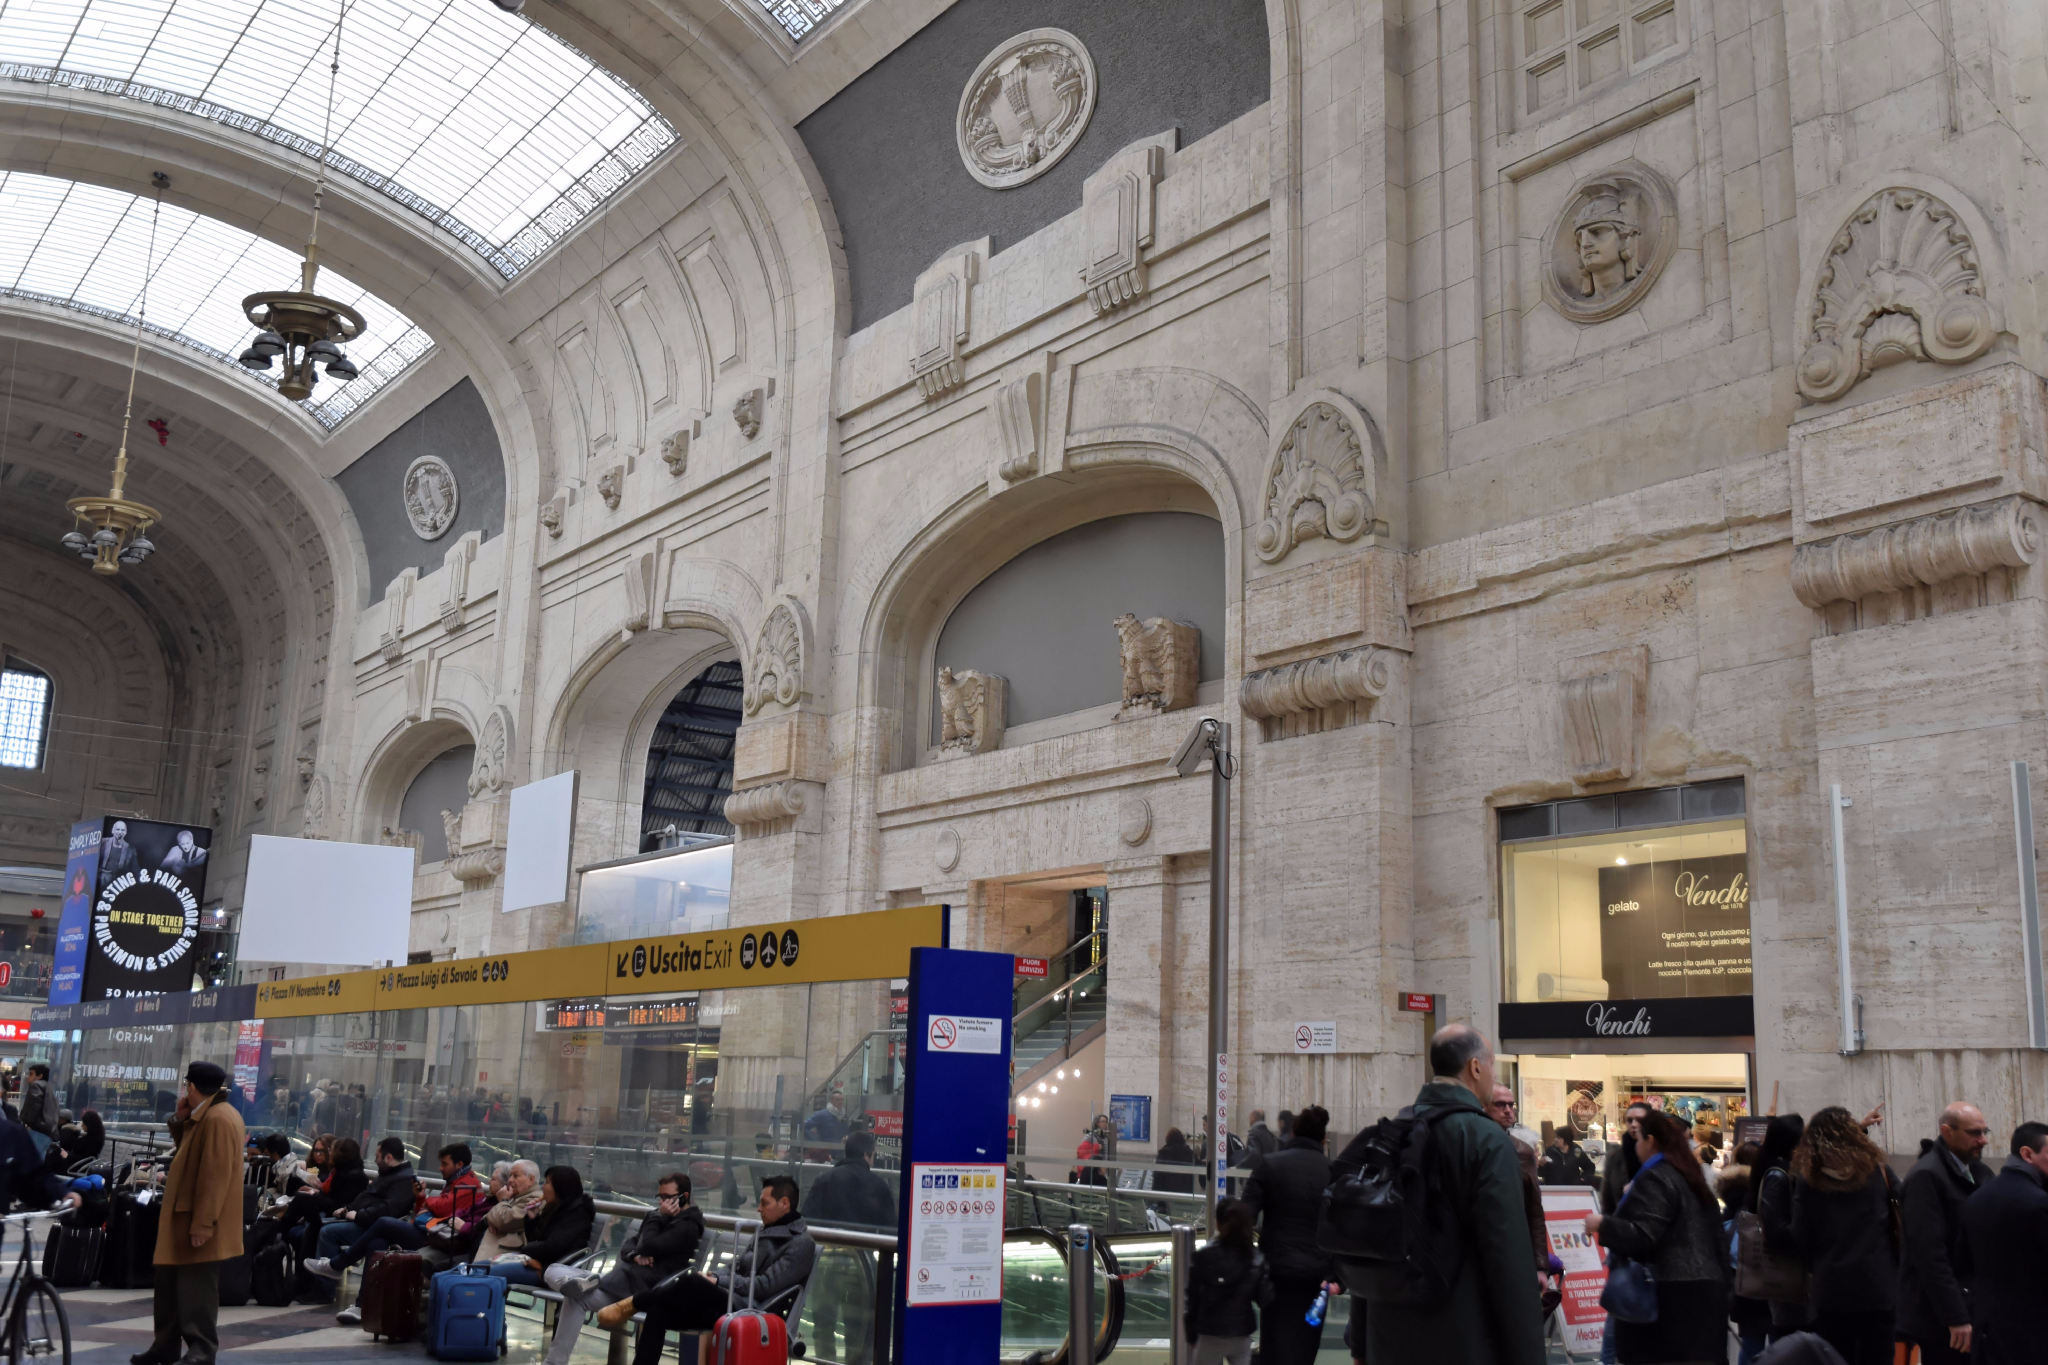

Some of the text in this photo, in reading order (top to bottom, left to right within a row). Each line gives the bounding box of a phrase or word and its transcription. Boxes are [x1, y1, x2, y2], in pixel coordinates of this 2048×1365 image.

[89, 831, 102, 846] RED
[139, 868, 151, 883] &
[153, 869, 182, 893] PAUL
[102, 871, 136, 901] STING
[1675, 871, 1749, 906] Venchi
[96, 900, 112, 912] &
[177, 887, 199, 926] SIMON
[1608, 900, 1640, 915] gelato
[110, 910, 184, 928] ON STAGE TOGETHER
[1661, 932, 1676, 940] Ogni
[1677, 931, 1697, 939] giorno,
[1710, 928, 1745, 937] produciamo
[94, 915, 198, 972] PAUL SIMON & STING &
[1690, 939, 1709, 948] miglior
[1711, 938, 1729, 947] gelato
[650, 939, 733, 974] Uscita Exit
[1022, 958, 1040, 966] FUORI
[1718, 958, 1737, 967] panna
[396, 965, 478, 990] Piazza Luigi di Savoia
[1018, 966, 1044, 974] SERVIZIO
[1683, 968, 1711, 976] Piemonte
[106, 988, 122, 998] 30
[271, 981, 326, 1000] Piazza IV Novembre
[1586, 1002, 1651, 1036] Venchi
[1552, 1231, 1593, 1250] EXPO
